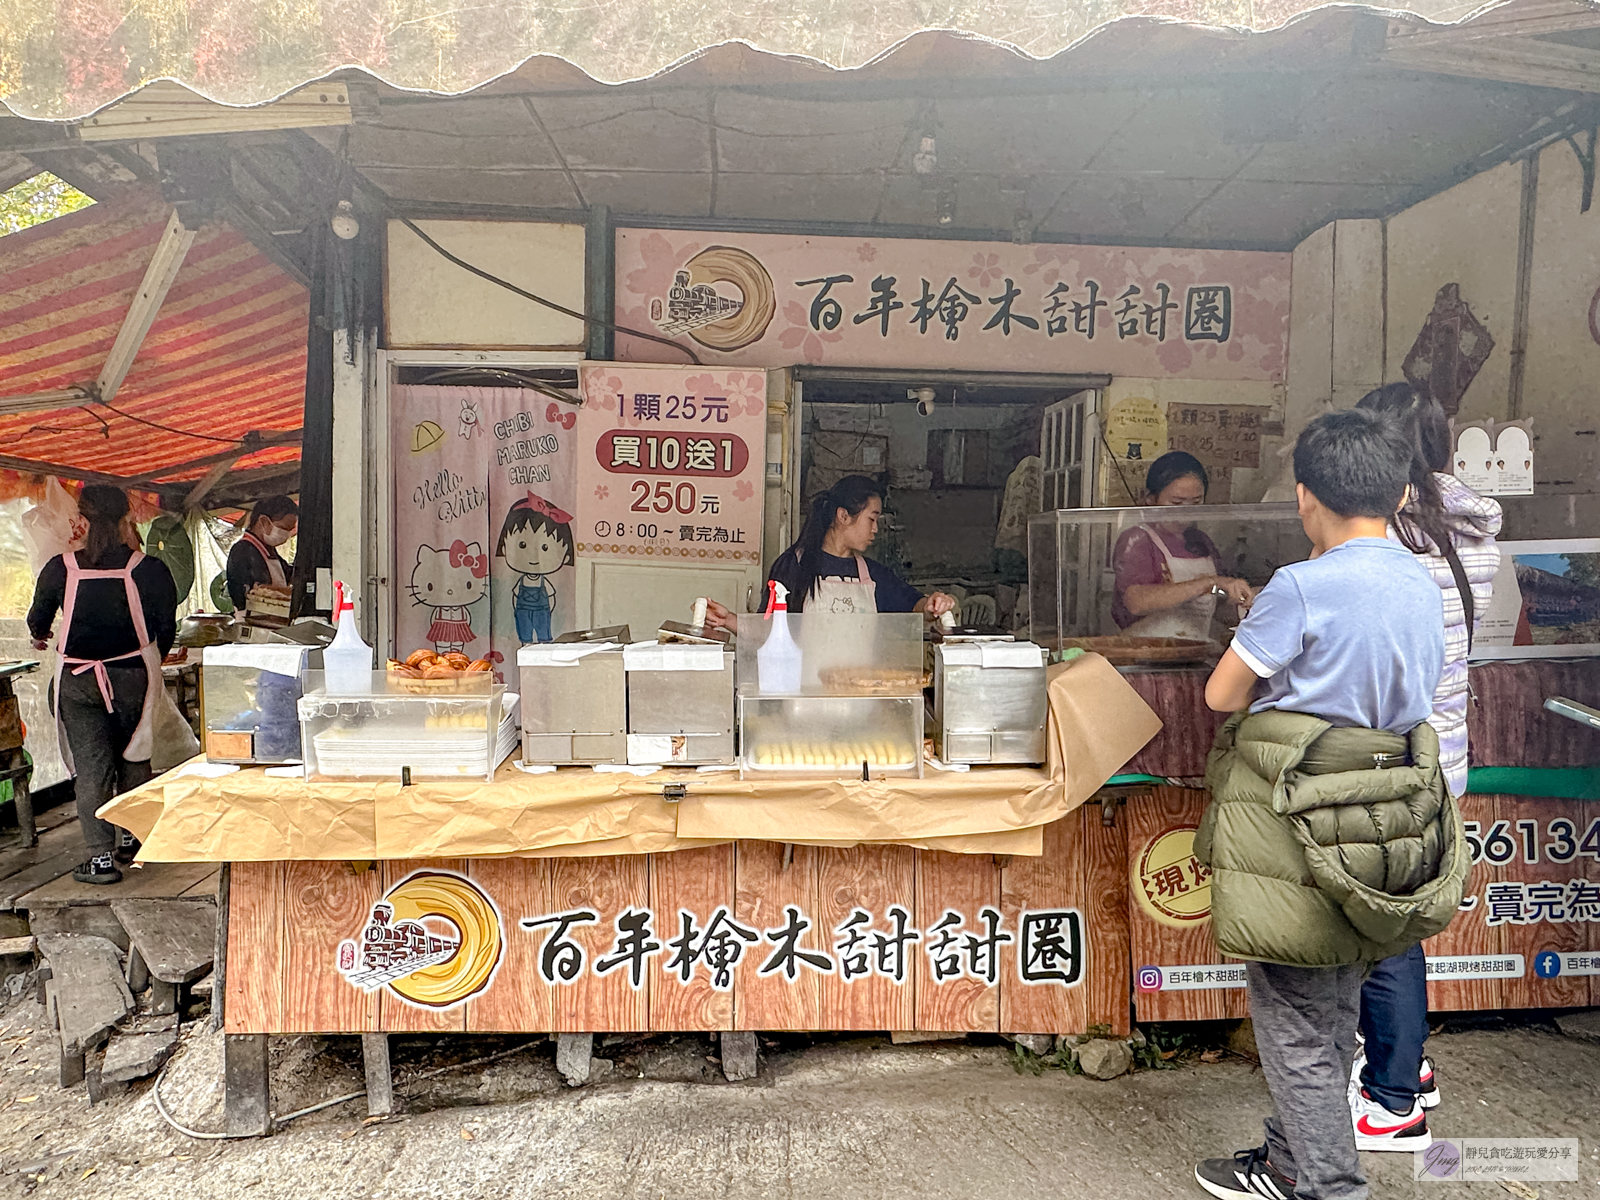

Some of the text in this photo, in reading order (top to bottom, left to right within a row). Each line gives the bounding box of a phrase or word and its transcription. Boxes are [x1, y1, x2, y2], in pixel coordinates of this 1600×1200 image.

[795, 274, 1232, 342] 百年檜木甜甜圈
[617, 393, 729, 423] 1顆25元
[494, 412, 535, 440] CHIBI
[497, 434, 559, 466] MARUKO
[611, 436, 733, 472] 買10送1
[413, 468, 463, 510] Hello
[508, 464, 551, 485] CHAN
[520, 906, 1082, 990] 百年檜木甜甜圈
